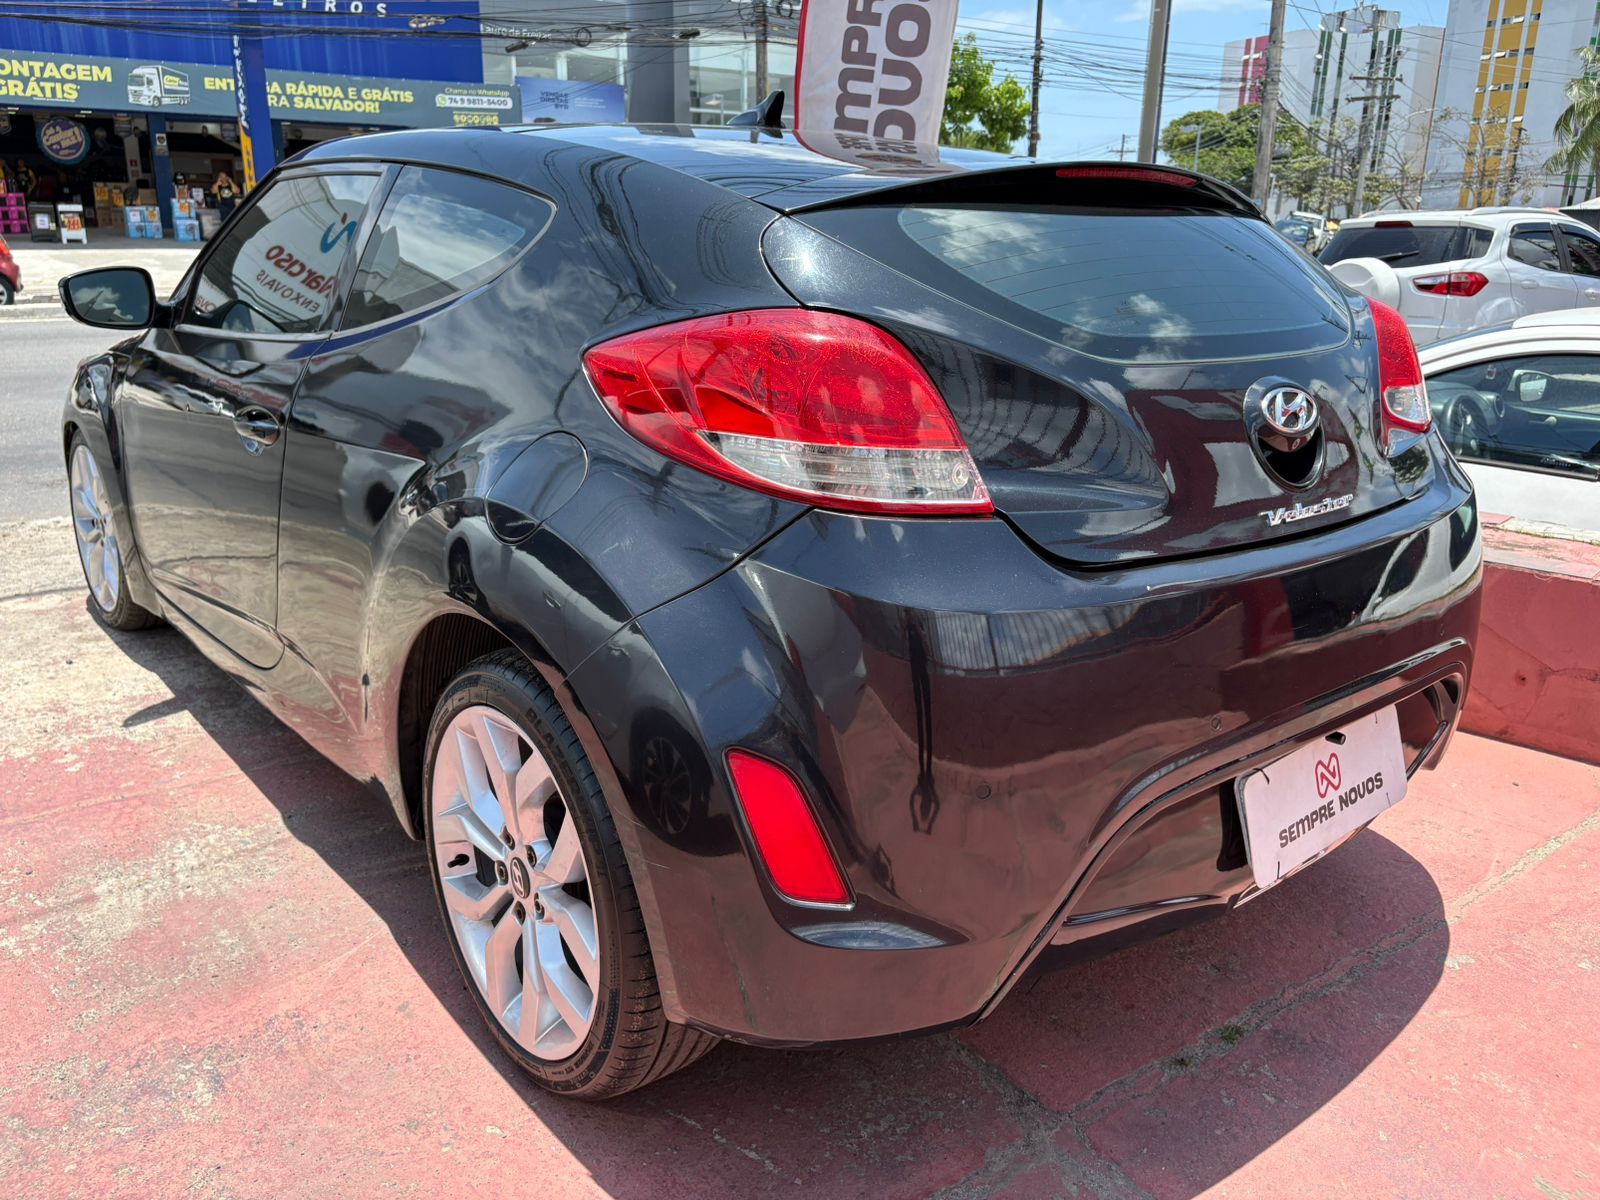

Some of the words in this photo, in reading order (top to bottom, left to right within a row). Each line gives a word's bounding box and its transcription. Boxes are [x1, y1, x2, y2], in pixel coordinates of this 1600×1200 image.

[480, 23, 507, 36] Lauro
[509, 27, 520, 37] de
[286, 81, 344, 98] RÁPIDA
[348, 87, 357, 99] E
[361, 87, 414, 103] GRÁTIS
[445, 87, 467, 95] Chama
[477, 89, 509, 97] WhatsApp
[293, 97, 380, 113] SALVADOR!
